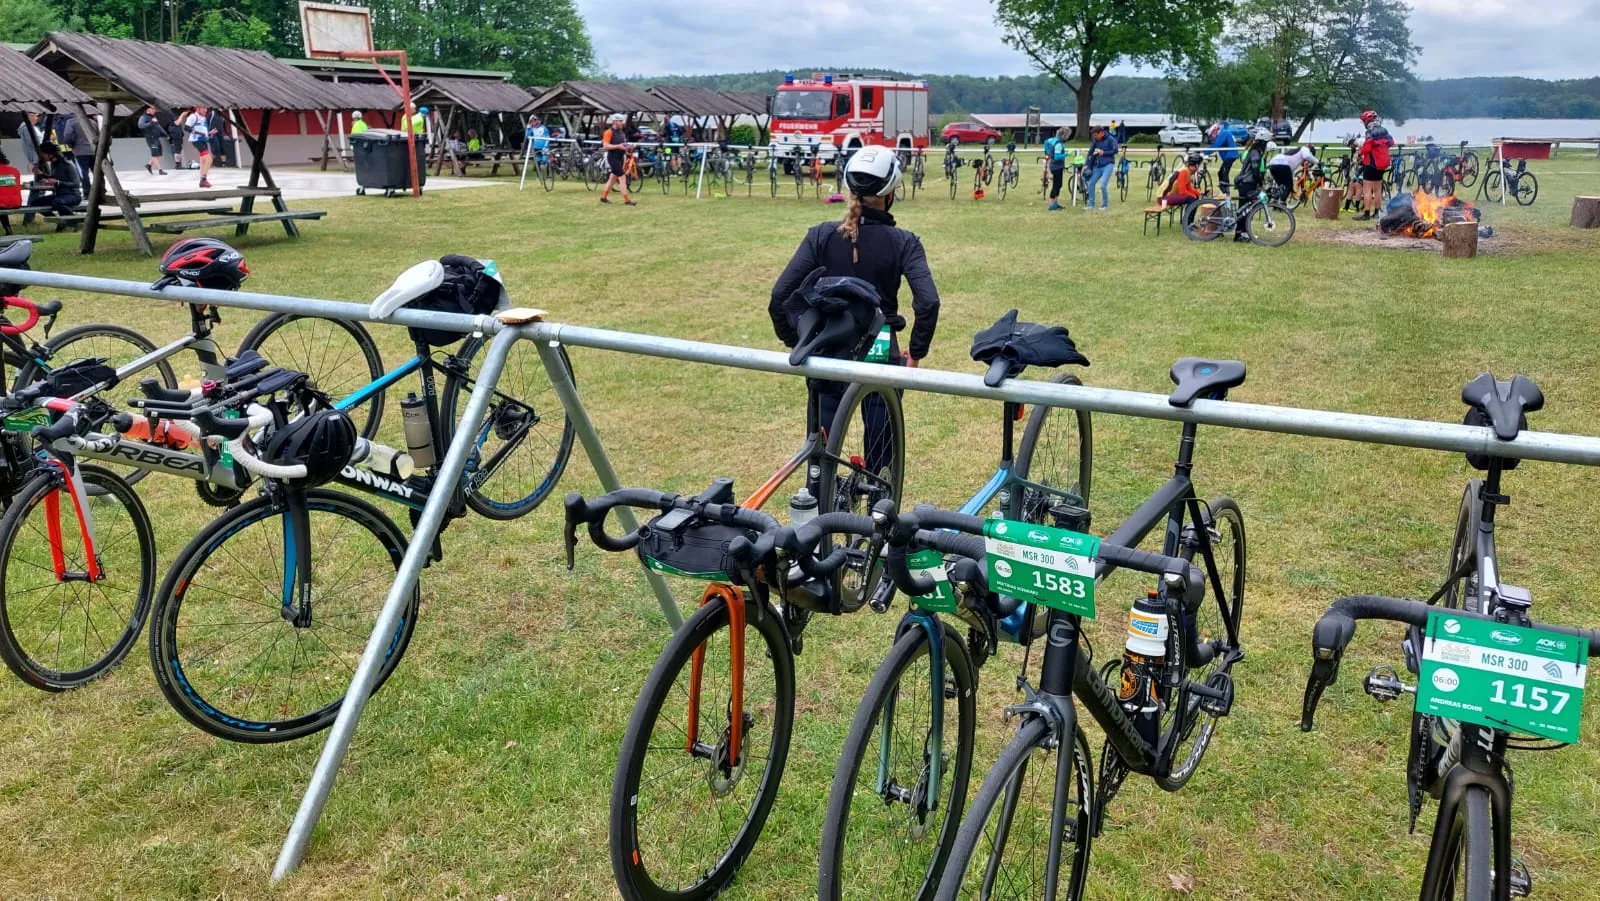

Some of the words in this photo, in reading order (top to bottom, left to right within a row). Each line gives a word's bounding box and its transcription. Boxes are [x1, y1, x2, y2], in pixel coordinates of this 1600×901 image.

[340, 464, 415, 499] ONWAY
[1022, 549, 1038, 561] MSR
[1040, 553, 1055, 565] 300
[1032, 571, 1086, 599] 1583
[1170, 614, 1181, 666] ULTEGRA
[1536, 638, 1557, 648] AOK
[1481, 652, 1505, 668] MSR
[1507, 658, 1528, 672] 300
[1433, 674, 1458, 687] 06:00
[1489, 679, 1571, 715] 1157
